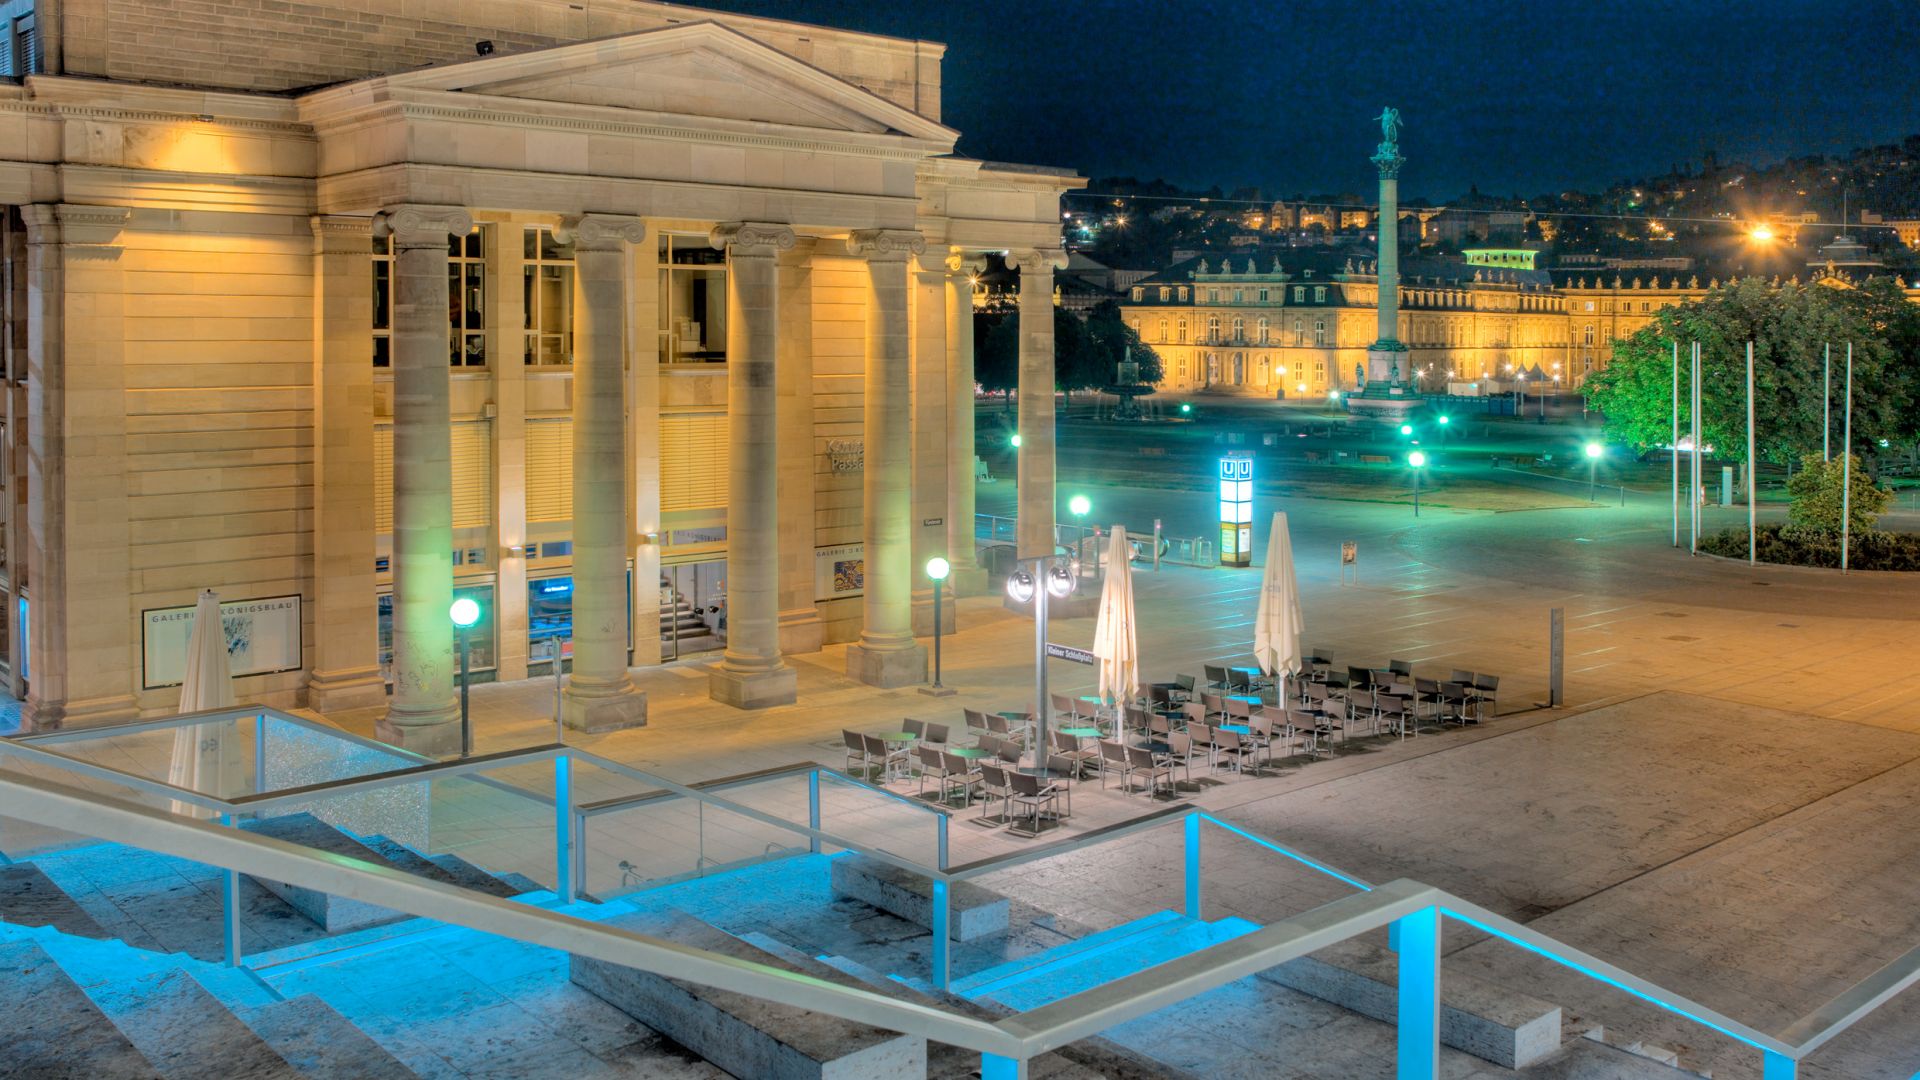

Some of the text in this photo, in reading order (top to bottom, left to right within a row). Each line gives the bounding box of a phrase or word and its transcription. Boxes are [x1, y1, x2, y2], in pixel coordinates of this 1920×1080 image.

[832, 457, 864, 471] Passa
[1223, 461, 1234, 474] U
[1240, 461, 1249, 474] U
[816, 549, 845, 557] GALERIE
[152, 602, 292, 623] GALERI KÖNIGSBLAU
[1048, 646, 1065, 656] Kleiner
